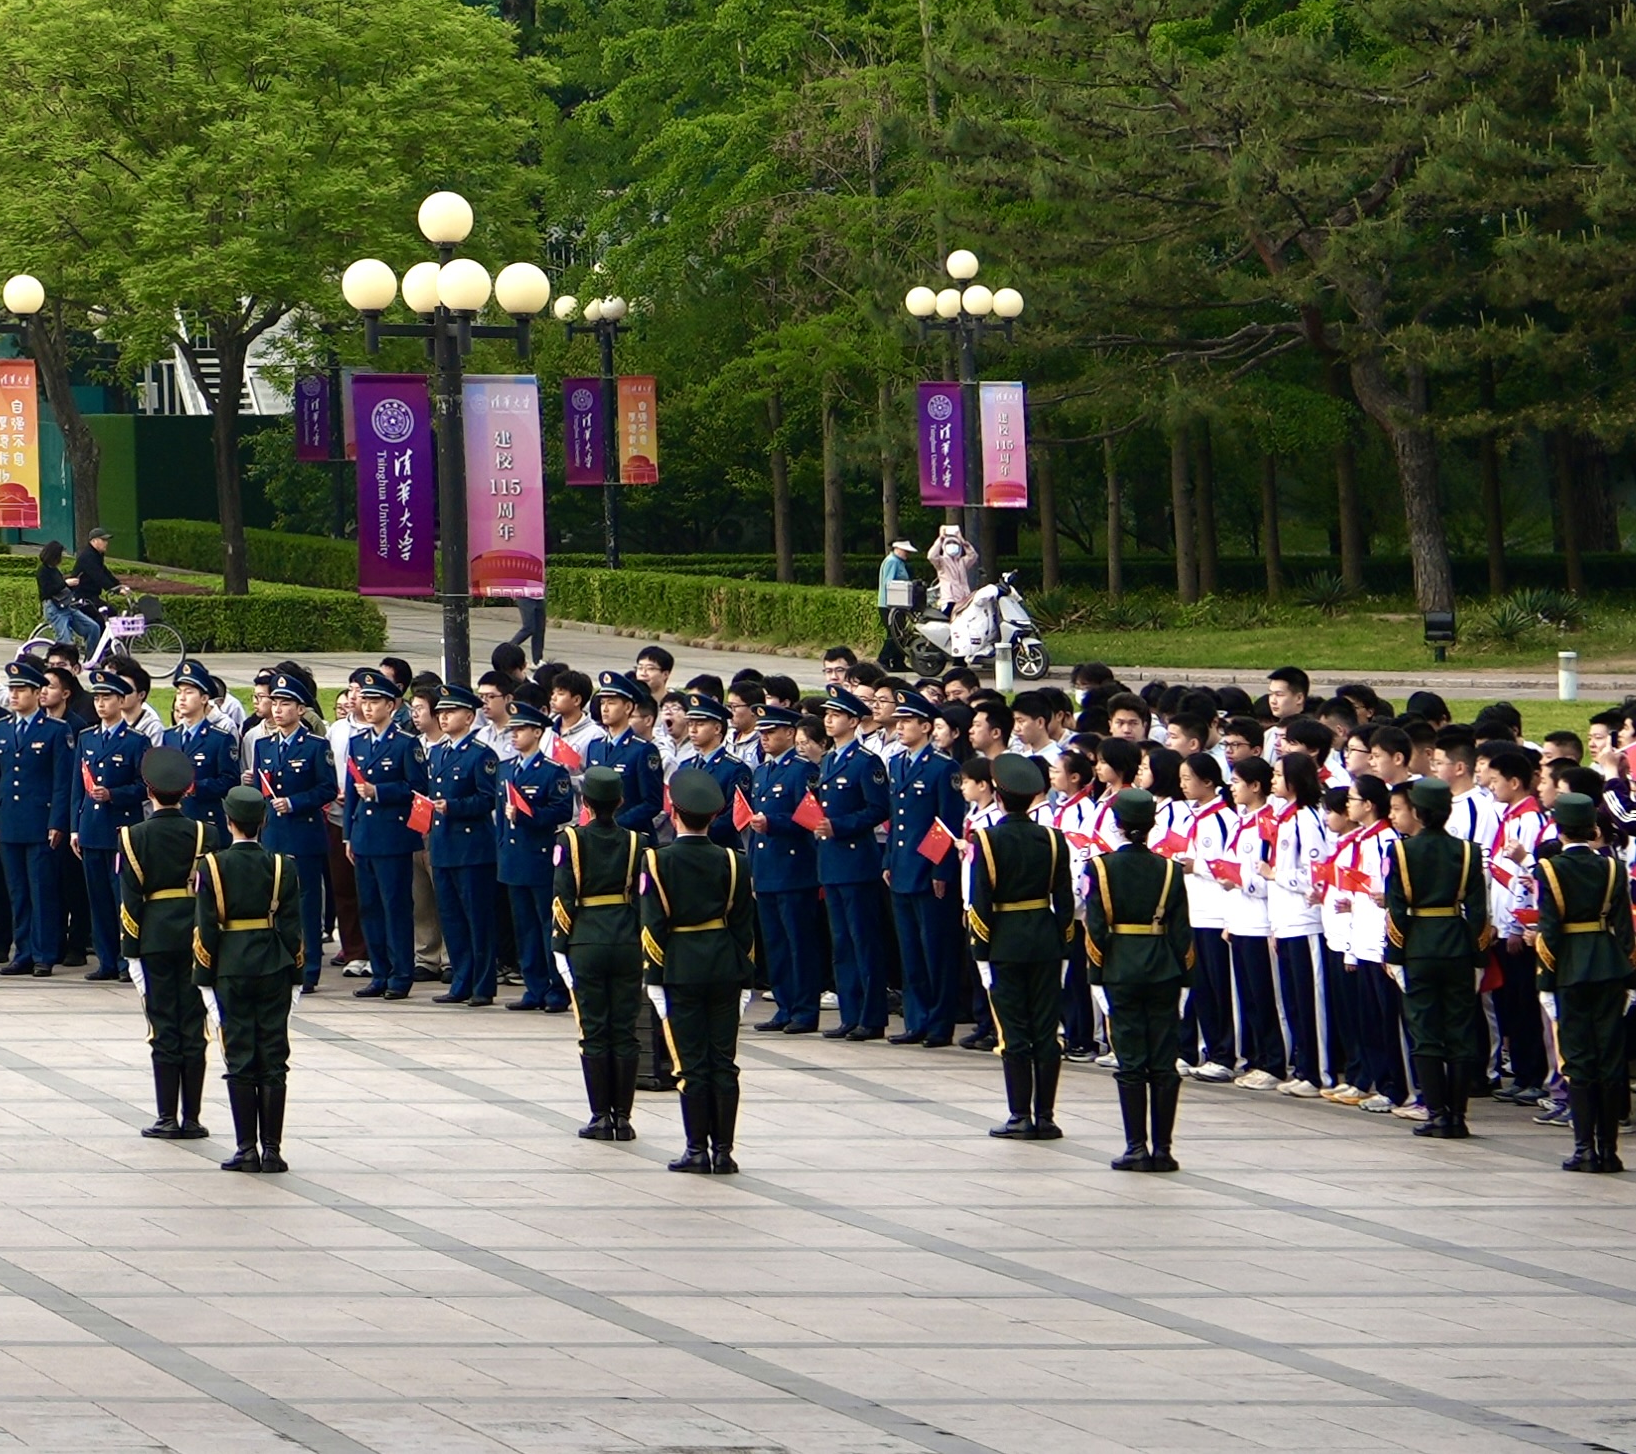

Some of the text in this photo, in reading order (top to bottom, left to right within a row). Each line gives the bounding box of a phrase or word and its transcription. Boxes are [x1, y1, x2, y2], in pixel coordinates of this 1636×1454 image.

[10, 399, 25, 467] 自强不息
[996, 413, 1015, 477] 建校115周年
[375, 450, 390, 559] Tsinghua University
[490, 430, 522, 541] 建校115周年
